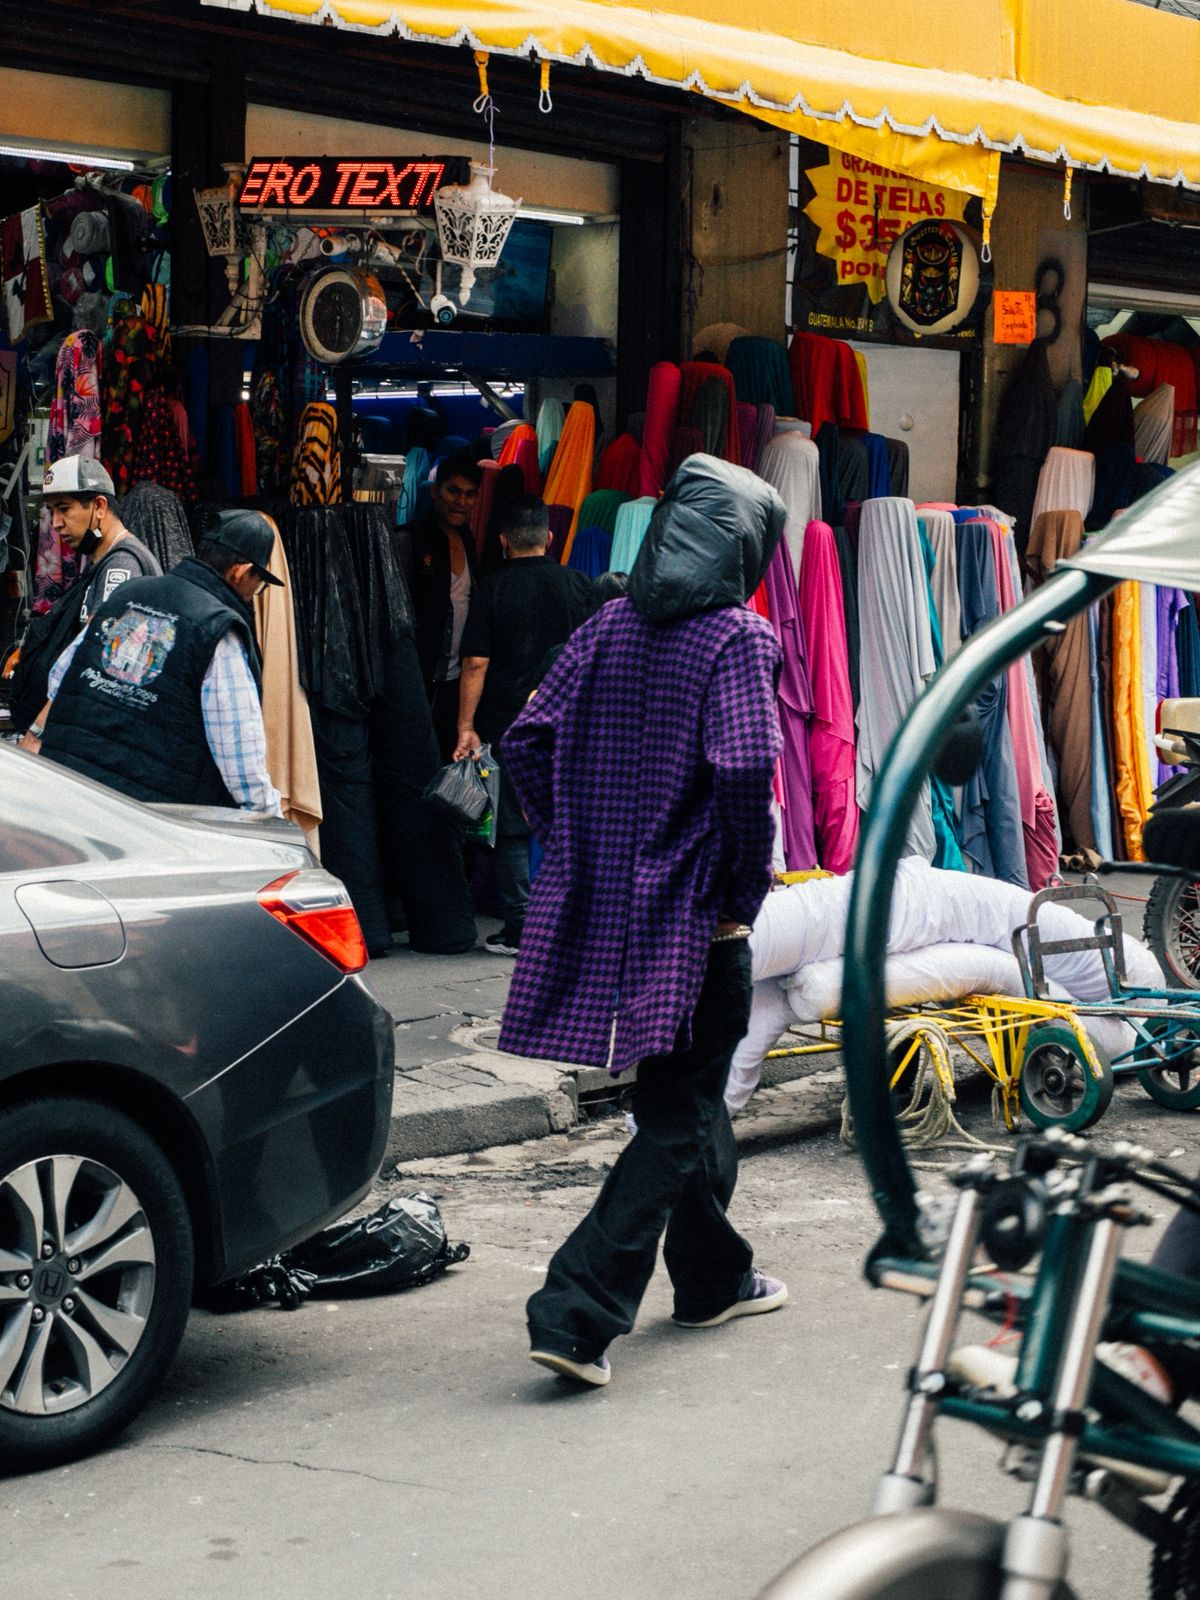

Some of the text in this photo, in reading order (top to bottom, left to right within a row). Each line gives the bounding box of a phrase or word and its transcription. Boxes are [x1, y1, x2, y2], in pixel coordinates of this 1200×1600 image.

[240, 163, 321, 204] ERO
[836, 176, 868, 206] DE
[874, 184, 945, 217] TELAS
